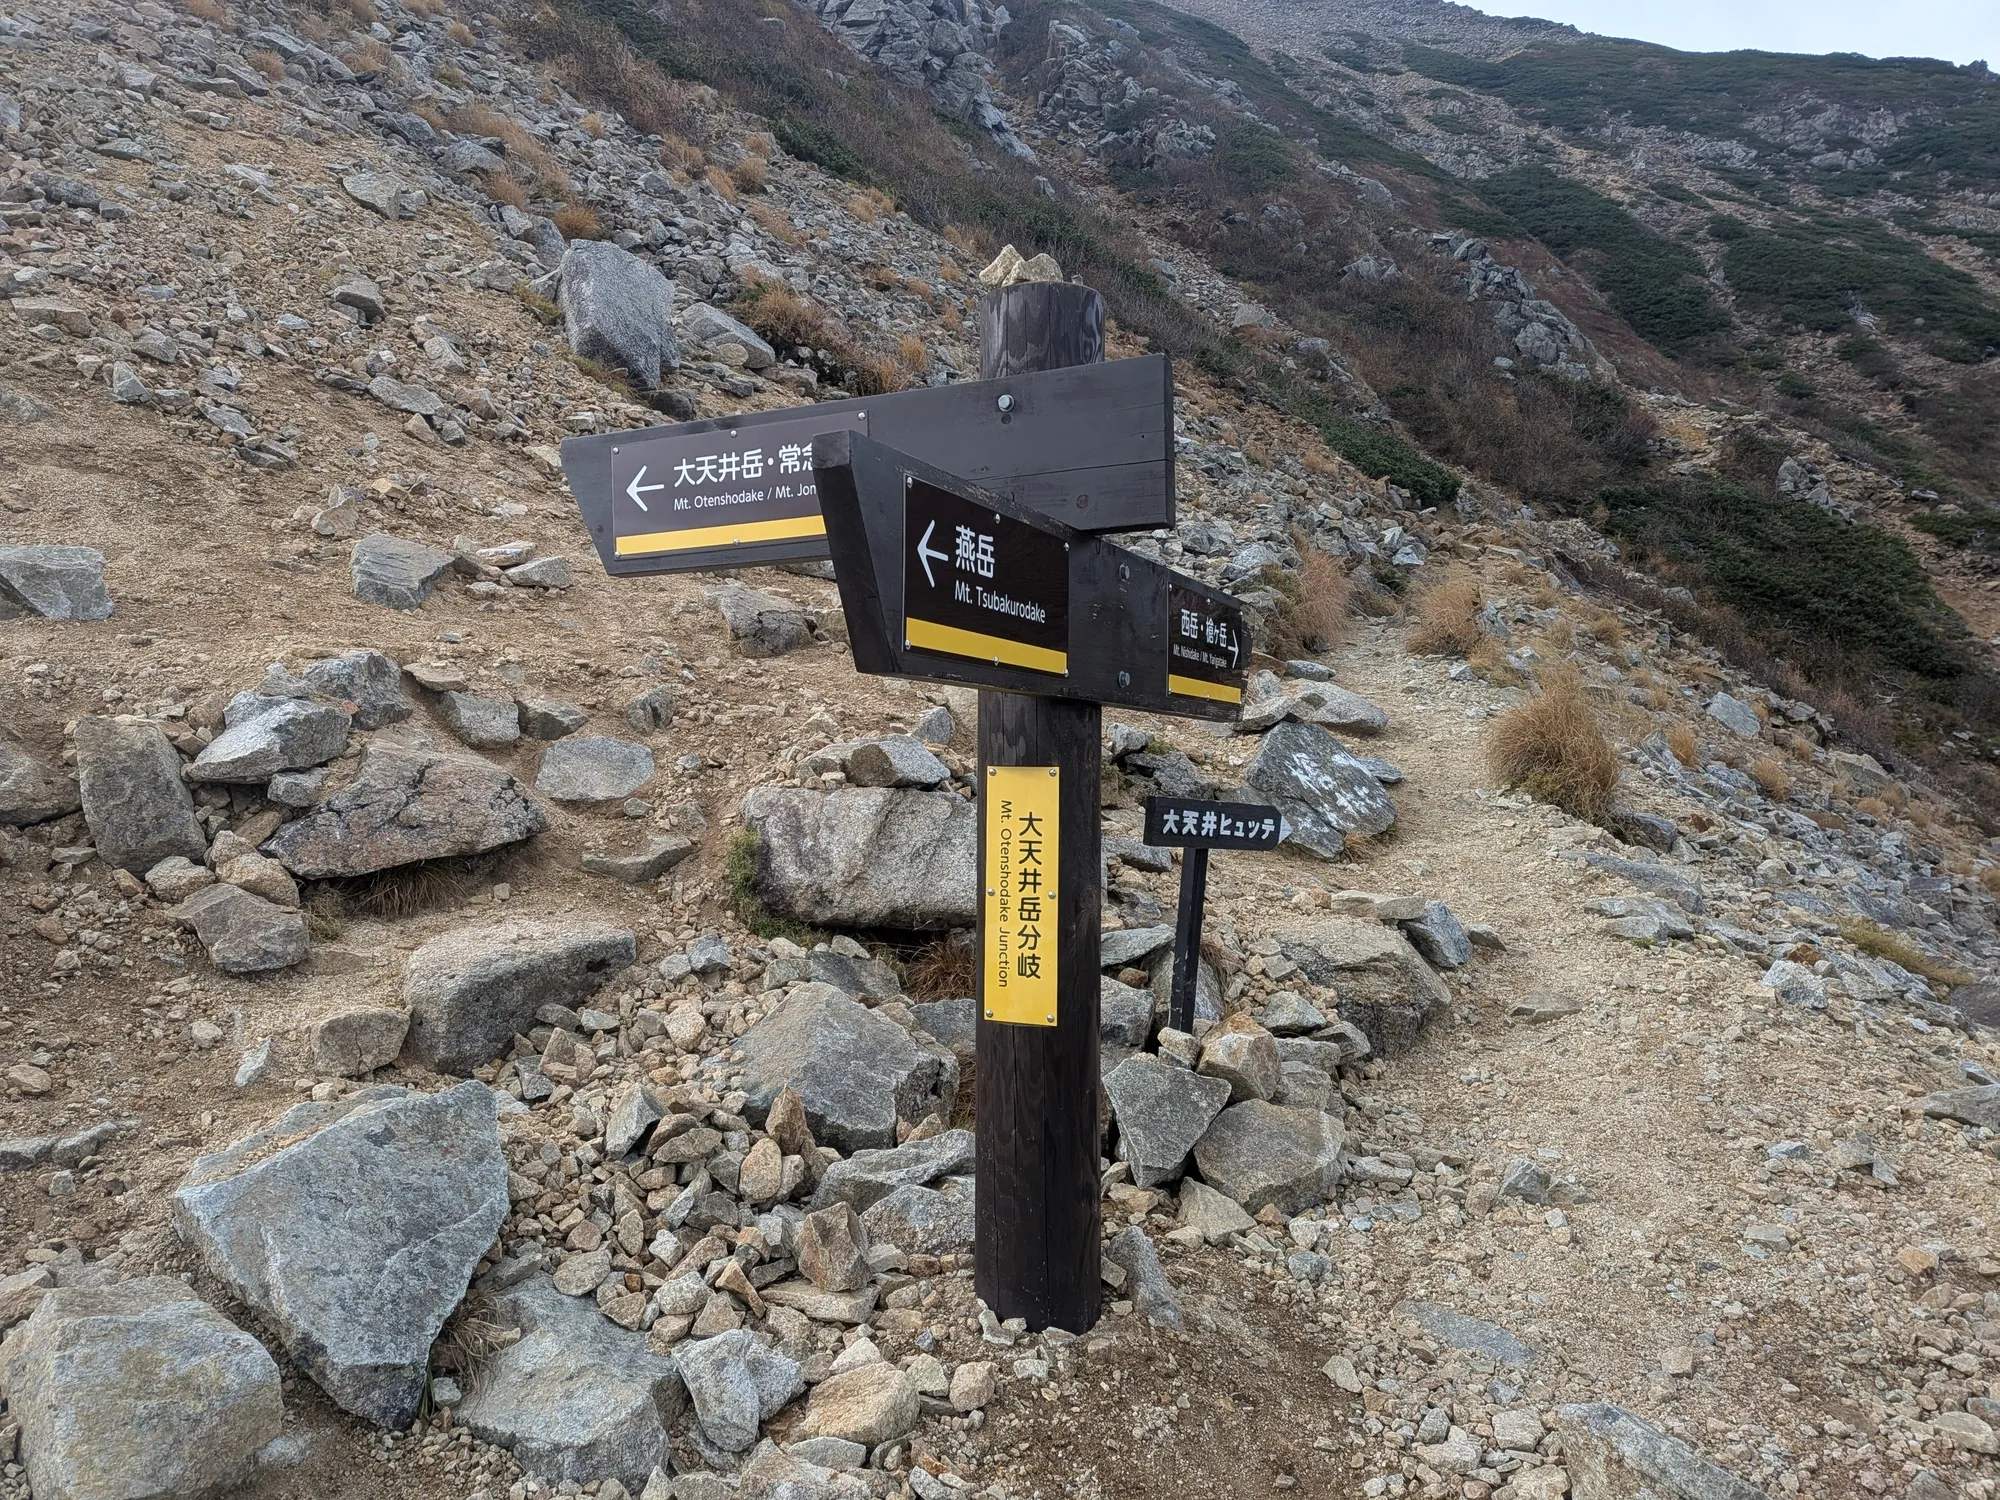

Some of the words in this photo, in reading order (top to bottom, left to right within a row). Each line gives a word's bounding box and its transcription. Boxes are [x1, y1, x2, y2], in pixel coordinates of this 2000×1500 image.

[674, 498, 691, 511] Mt.
[694, 487, 764, 507] Otenshodake
[775, 486, 793, 500] Mt.
[955, 524, 995, 579] 燕岳
[954, 580, 973, 605] Mt.
[976, 586, 1046, 623] Tsubakurodake
[1000, 800, 1012, 824] Mt.
[1163, 808, 1275, 840] 大天井ヒュッテ
[999, 828, 1012, 923] Otenshodake
[1017, 811, 1043, 980] 大天井岳分岐
[998, 927, 1010, 988] Junction
